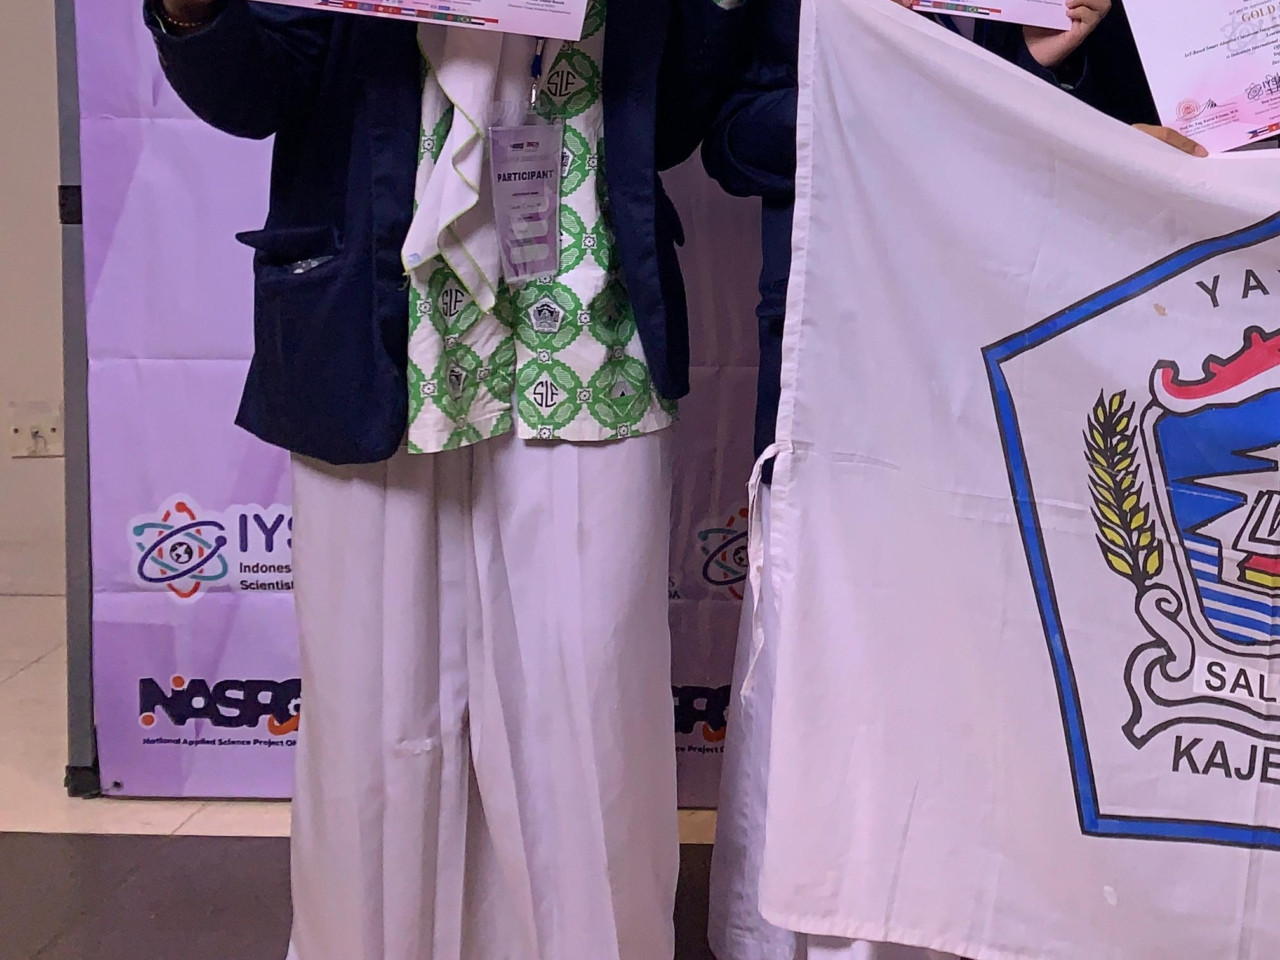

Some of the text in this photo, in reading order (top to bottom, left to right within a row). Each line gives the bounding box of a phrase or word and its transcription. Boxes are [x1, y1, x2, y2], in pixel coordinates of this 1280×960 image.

[1241, 5, 1276, 22] GOLD
[497, 169, 554, 182] PARTICIPANT
[239, 513, 293, 553] IY
[239, 562, 292, 574] Indones
[182, 738, 216, 748] Applied
[218, 738, 252, 747] Science
[253, 738, 284, 749] Project
